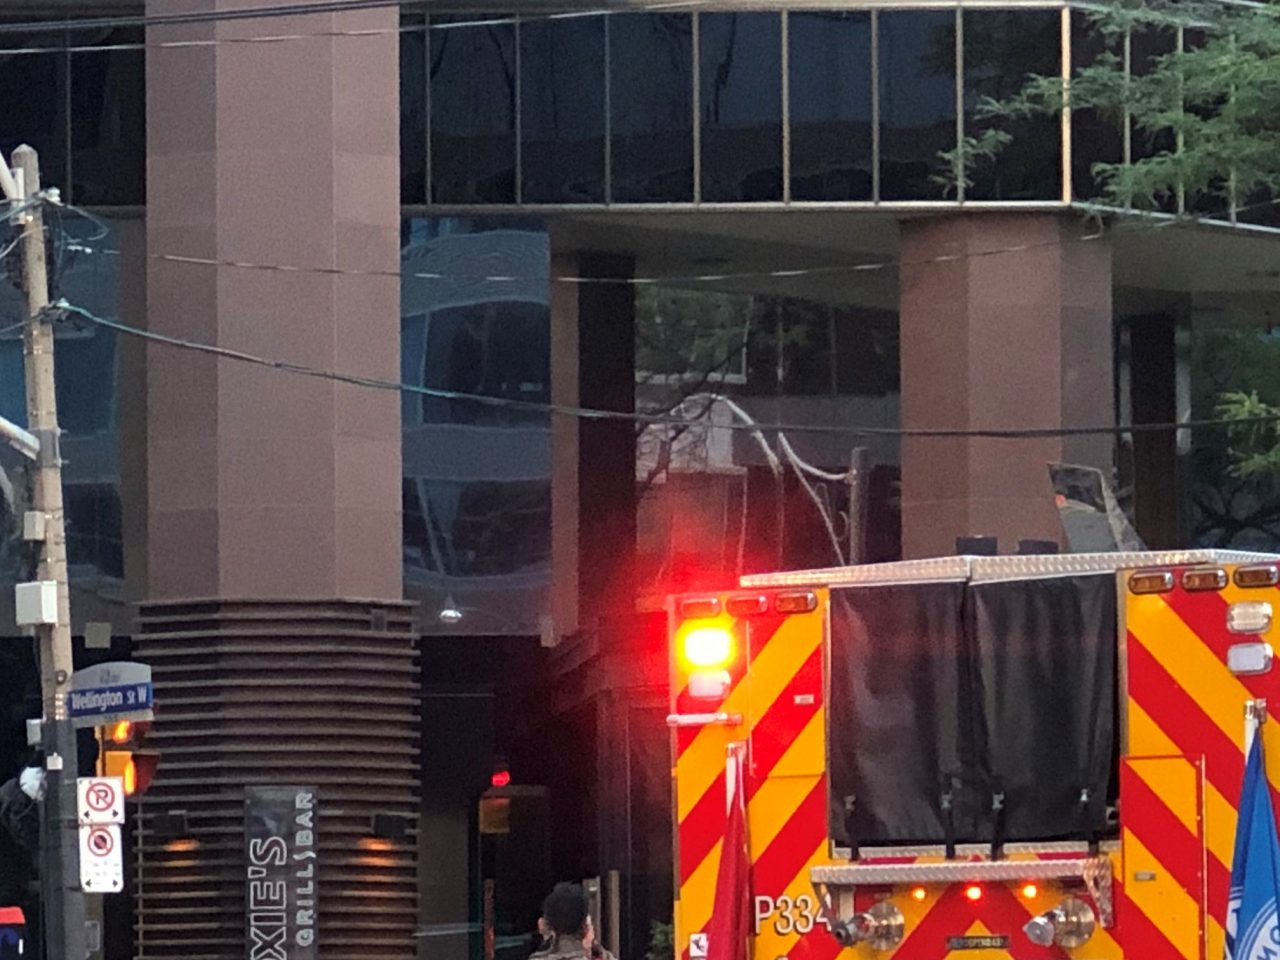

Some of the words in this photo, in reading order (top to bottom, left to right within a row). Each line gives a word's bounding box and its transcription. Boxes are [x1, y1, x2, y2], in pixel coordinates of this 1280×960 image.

[71, 690, 123, 711] Wellington
[126, 690, 136, 704] St
[137, 686, 147, 703] W
[295, 792, 314, 847] BAR
[295, 864, 314, 947] GRILL
[754, 895, 832, 934] P334
